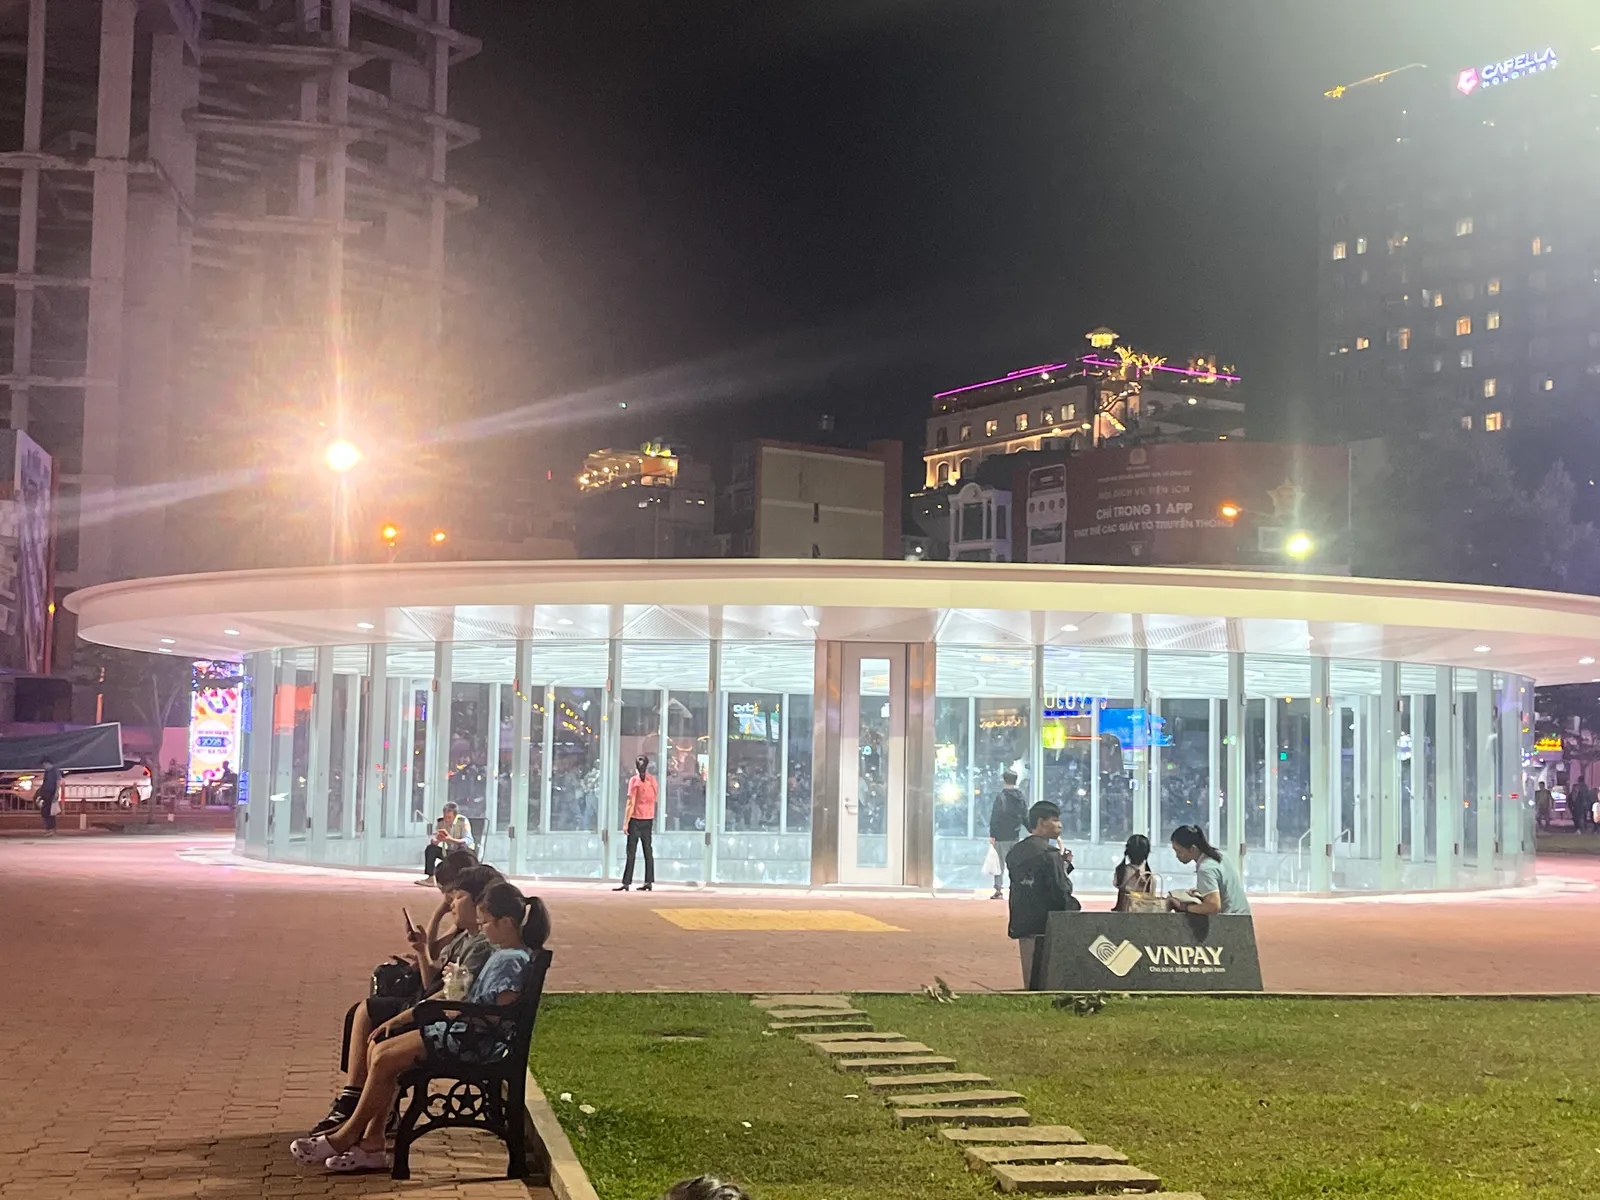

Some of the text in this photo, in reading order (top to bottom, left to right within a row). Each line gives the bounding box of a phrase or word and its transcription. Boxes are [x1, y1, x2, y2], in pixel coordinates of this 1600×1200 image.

[1481, 47, 1557, 79] CAPELLA
[1113, 504, 1151, 518] TRONG
[1155, 503, 1161, 515] 1
[1166, 502, 1193, 514] APP
[1144, 946, 1224, 965] VNPAY
